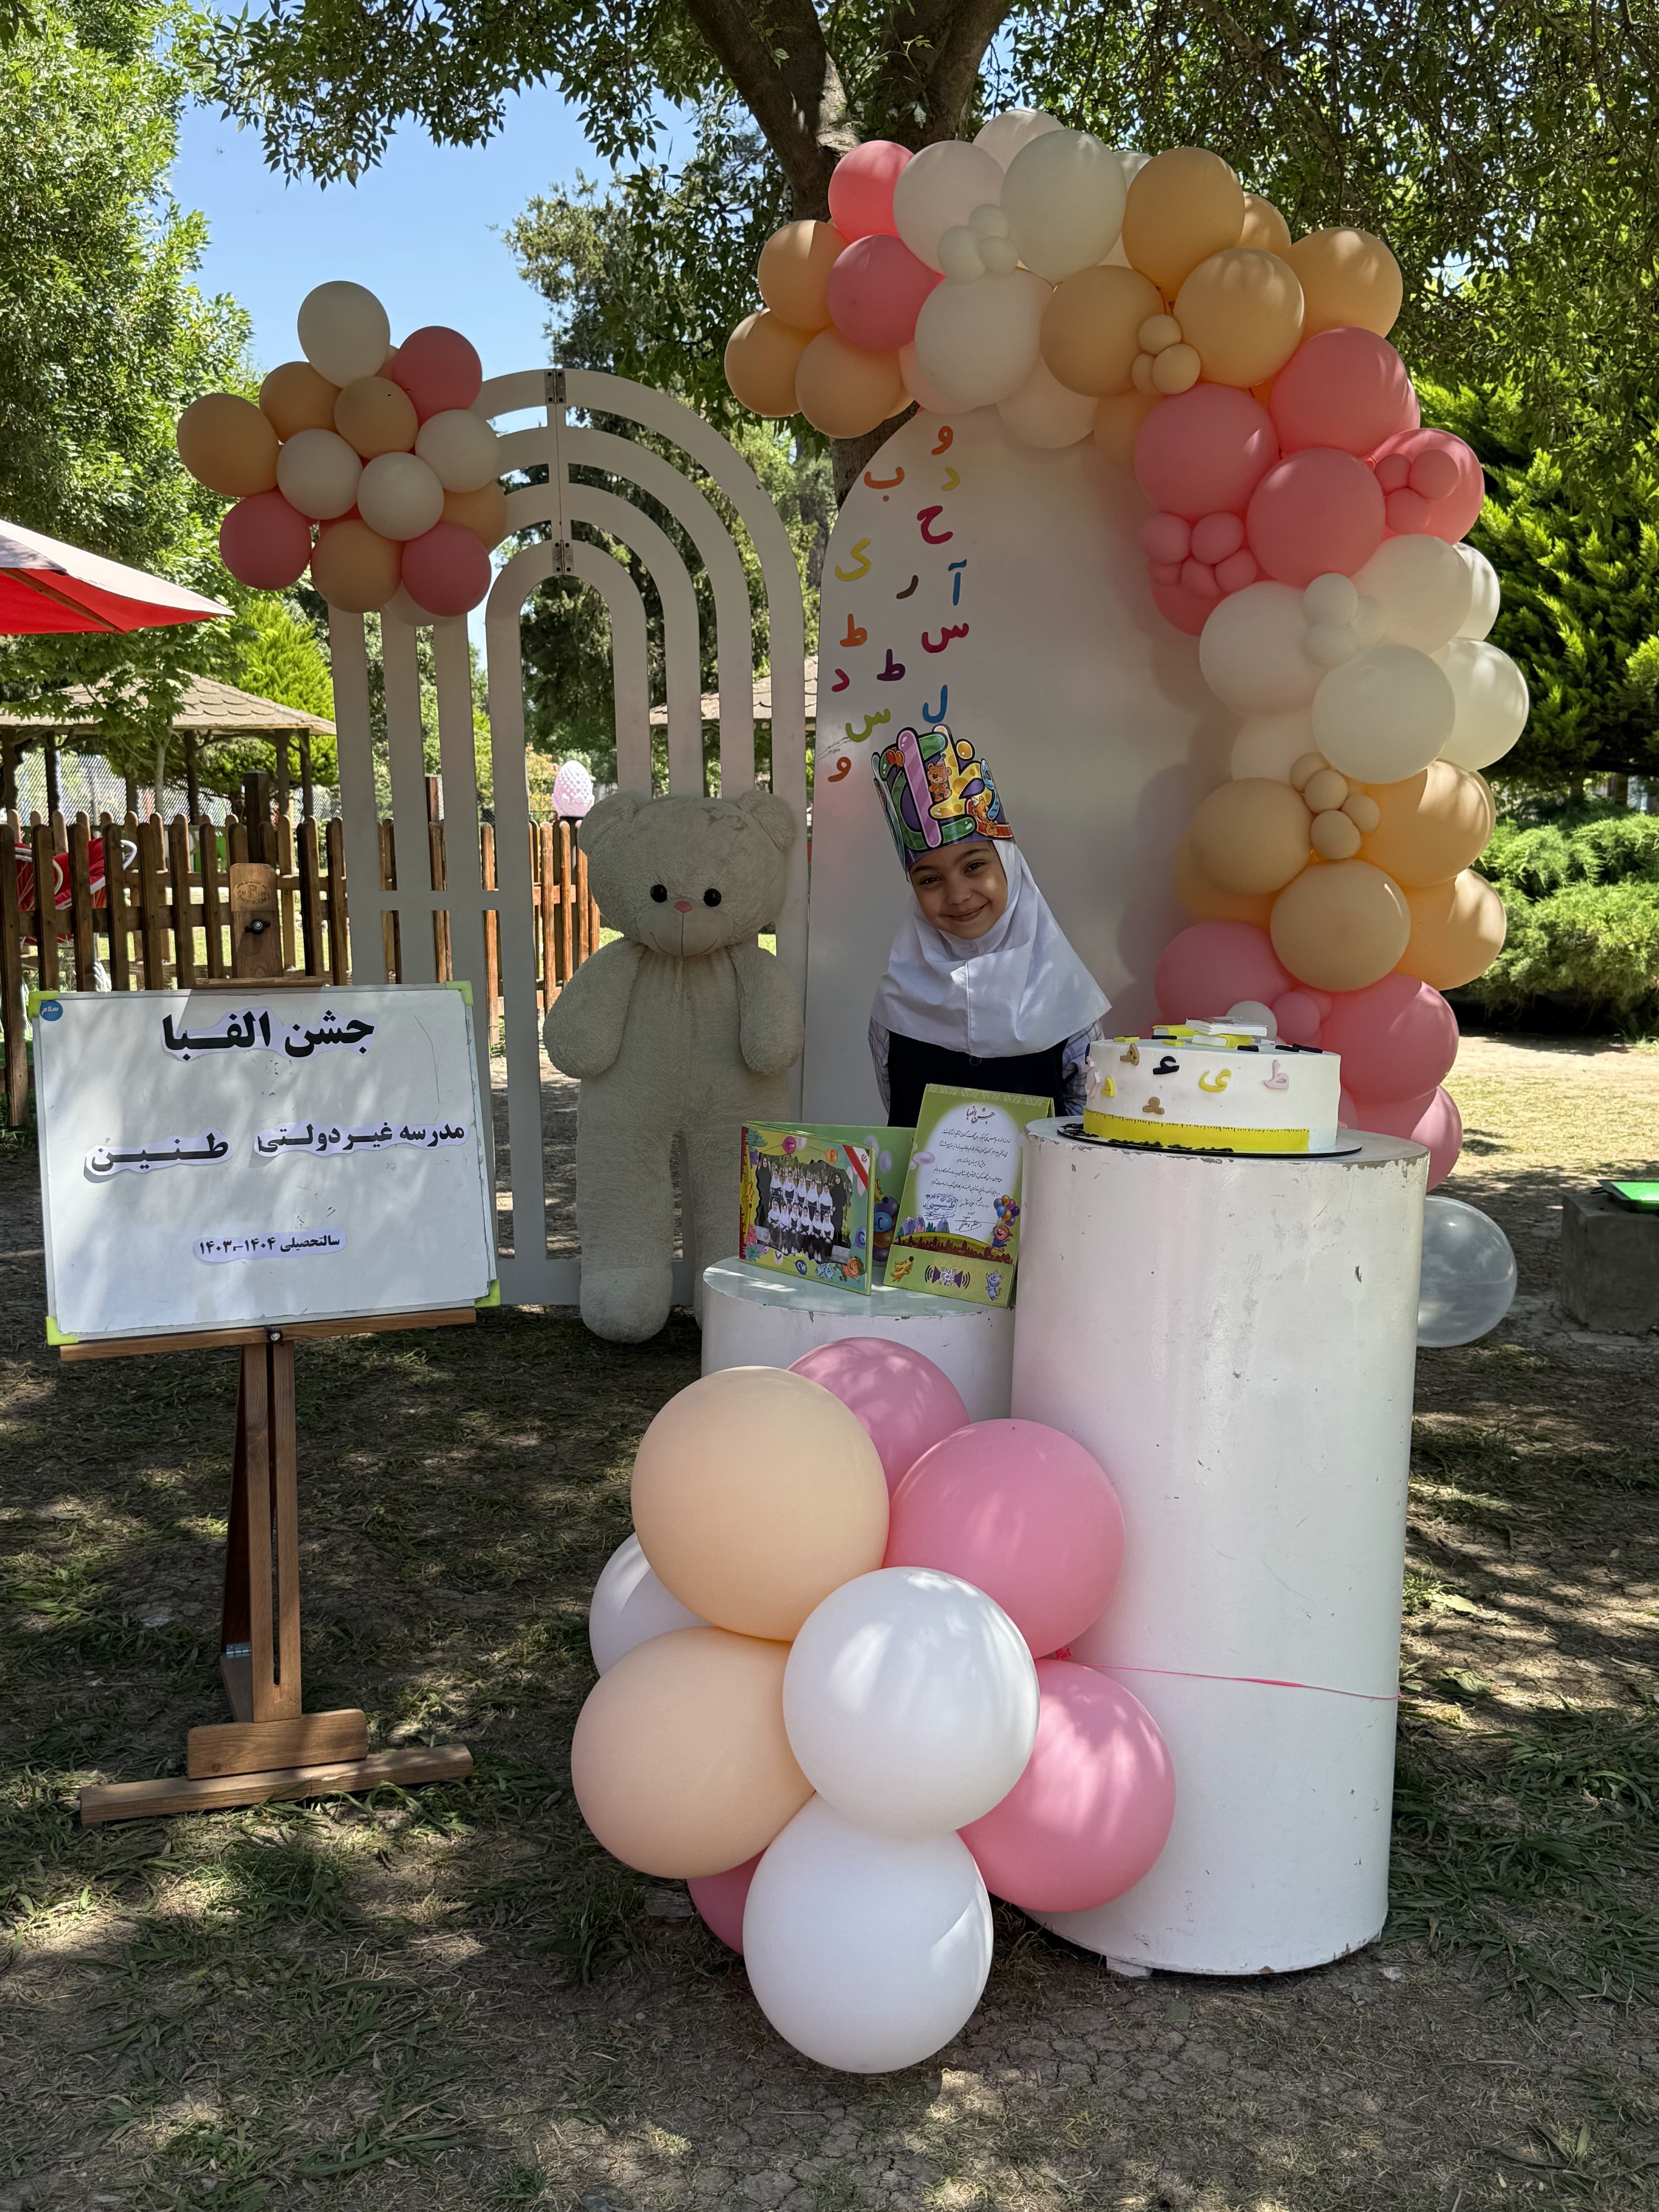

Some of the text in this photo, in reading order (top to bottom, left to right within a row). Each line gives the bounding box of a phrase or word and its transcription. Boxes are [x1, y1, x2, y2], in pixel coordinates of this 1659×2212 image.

[931, 426, 953, 455] و
[864, 467, 905, 502] ب
[941, 467, 960, 491] د
[917, 505, 953, 544] ح
[896, 575, 918, 599] ر
[948, 559, 967, 606] آ
[839, 613, 868, 647] ط
[922, 623, 969, 653] س
[832, 669, 850, 692] د
[877, 649, 906, 681] ط
[922, 685, 948, 724] ل
[845, 708, 891, 742] س
[828, 757, 851, 782] و
[42, 1006, 59, 1016] سلام
[162, 1010, 375, 1061] جشن الفبا
[399, 1123, 464, 1147] مدرسه
[91, 1133, 229, 1170] طنین
